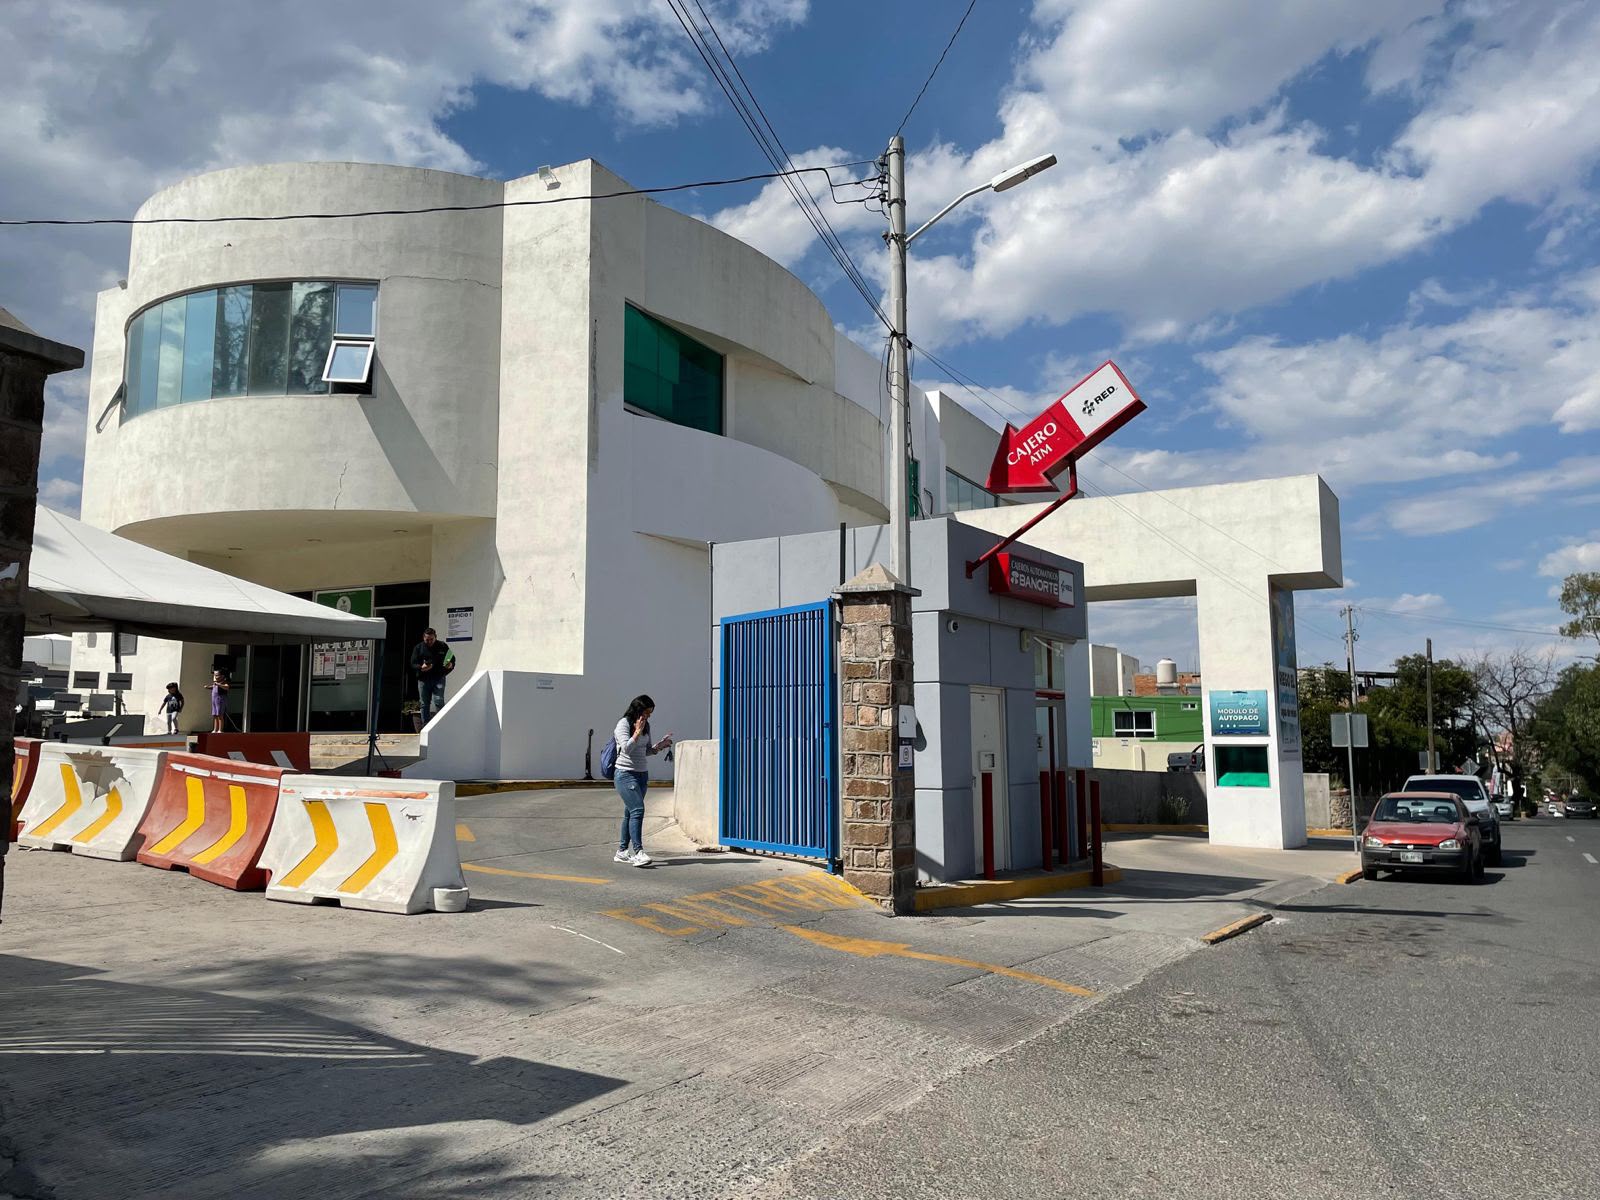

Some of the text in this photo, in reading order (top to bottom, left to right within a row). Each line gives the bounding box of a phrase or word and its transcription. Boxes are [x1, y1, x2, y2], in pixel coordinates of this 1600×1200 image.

[1094, 385, 1116, 405] RED
[1007, 422, 1057, 466] CAJERO
[1029, 443, 1053, 466] ATM
[1019, 574, 1059, 595] BANORTE
